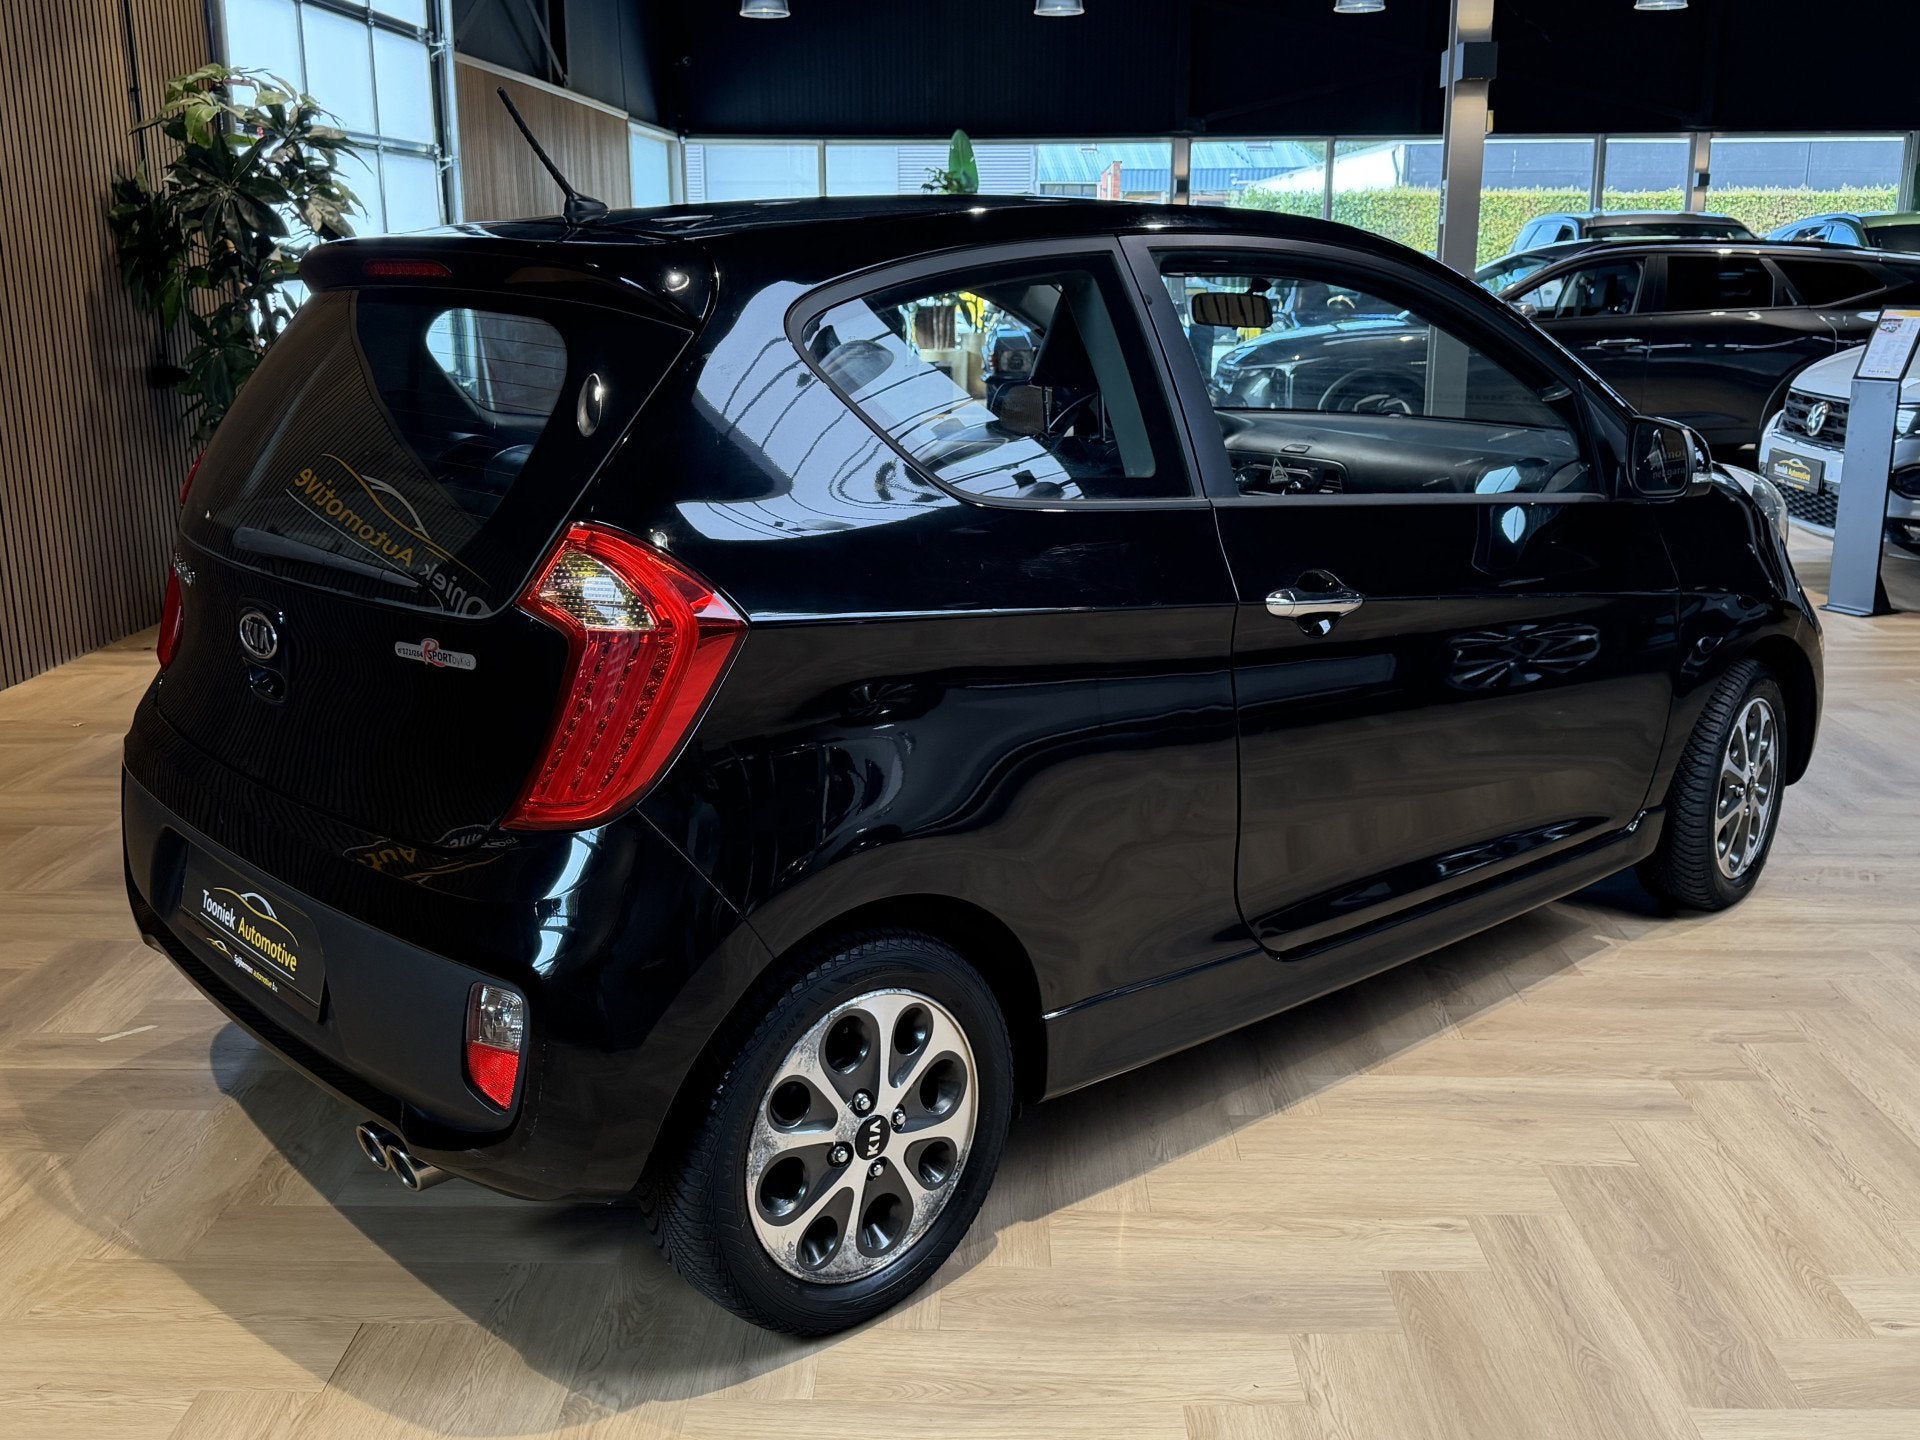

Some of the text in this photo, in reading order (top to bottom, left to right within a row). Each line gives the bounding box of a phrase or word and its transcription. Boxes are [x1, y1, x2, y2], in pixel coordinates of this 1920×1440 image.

[243, 618, 272, 655] KIA
[202, 889, 298, 972] Tooniek Automotive
[866, 1119, 881, 1157] KIA
